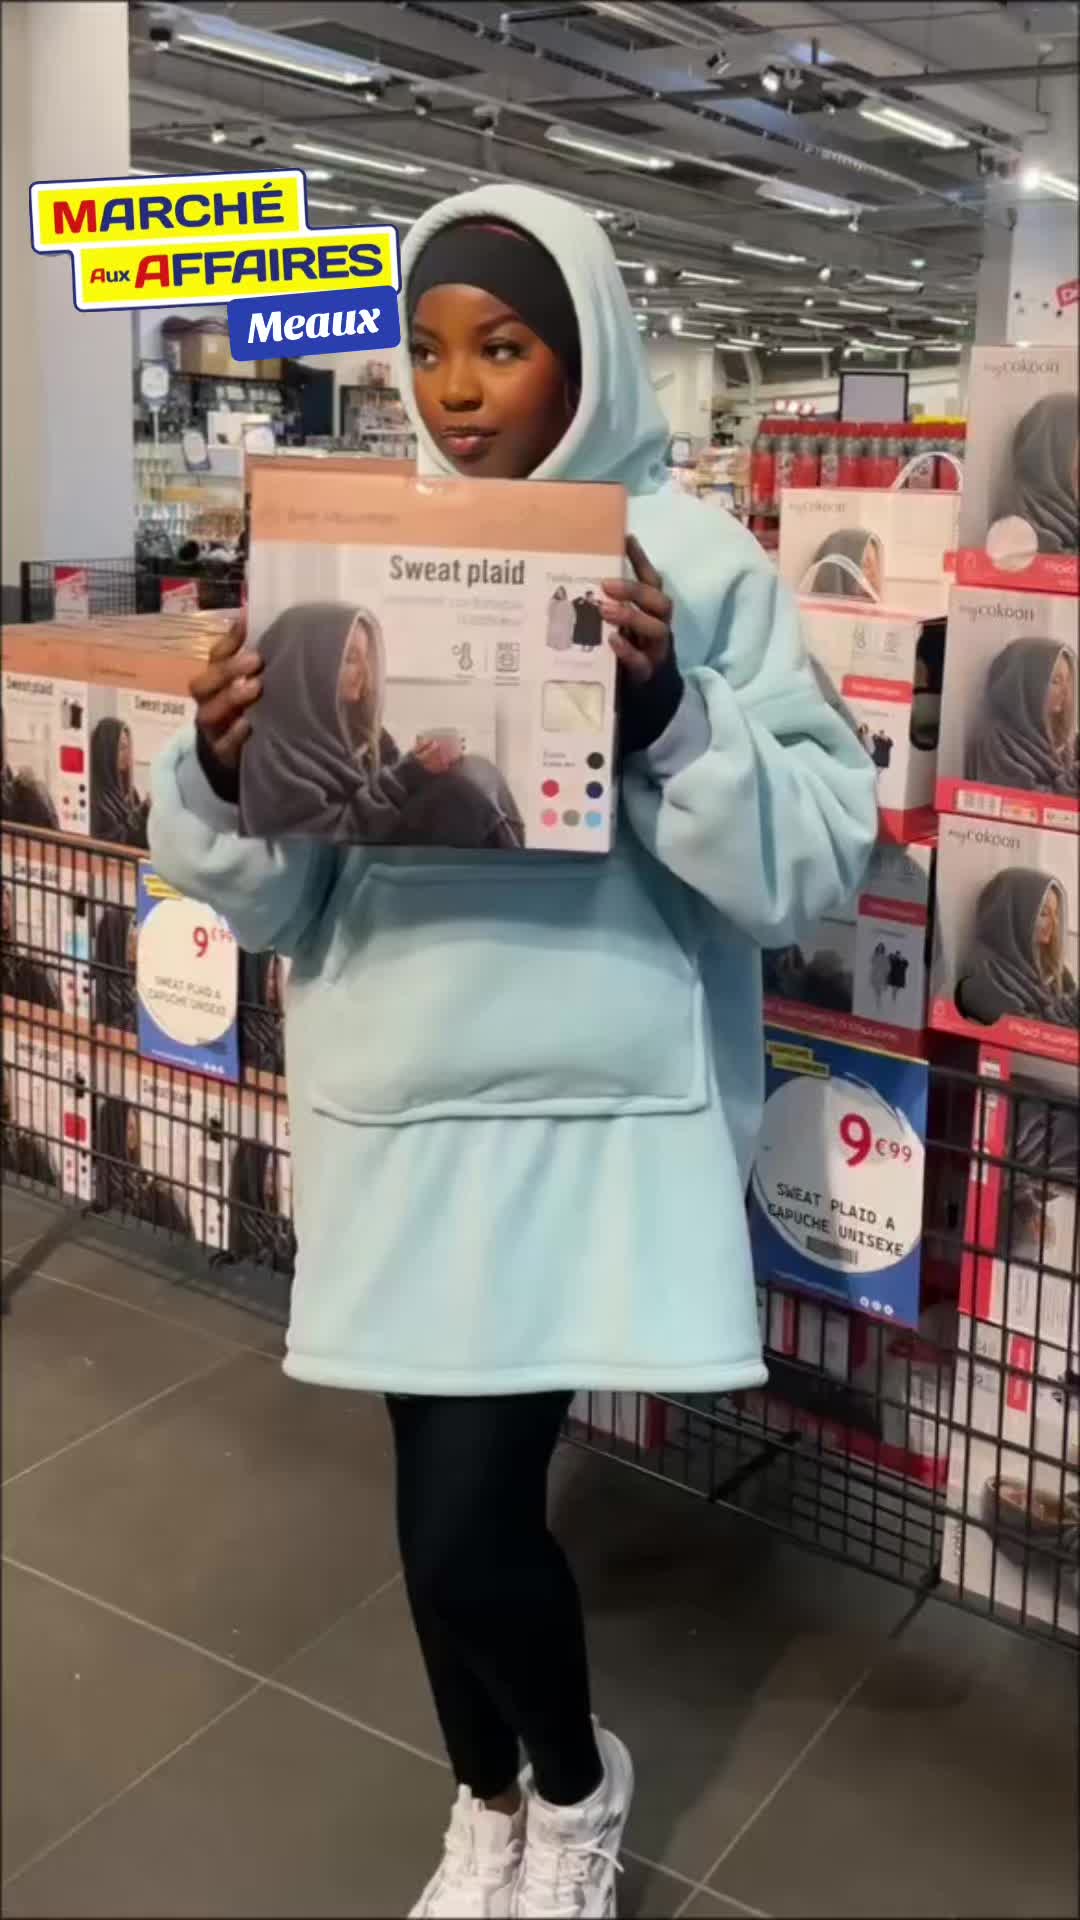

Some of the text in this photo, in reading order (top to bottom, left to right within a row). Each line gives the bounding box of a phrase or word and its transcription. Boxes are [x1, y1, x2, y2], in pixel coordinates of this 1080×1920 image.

[389, 555, 526, 588] Sweat plaid
[767, 1203, 905, 1258] CAPUCHE UNISEXE
[776, 1182, 896, 1231] SWEAT PLAID A
